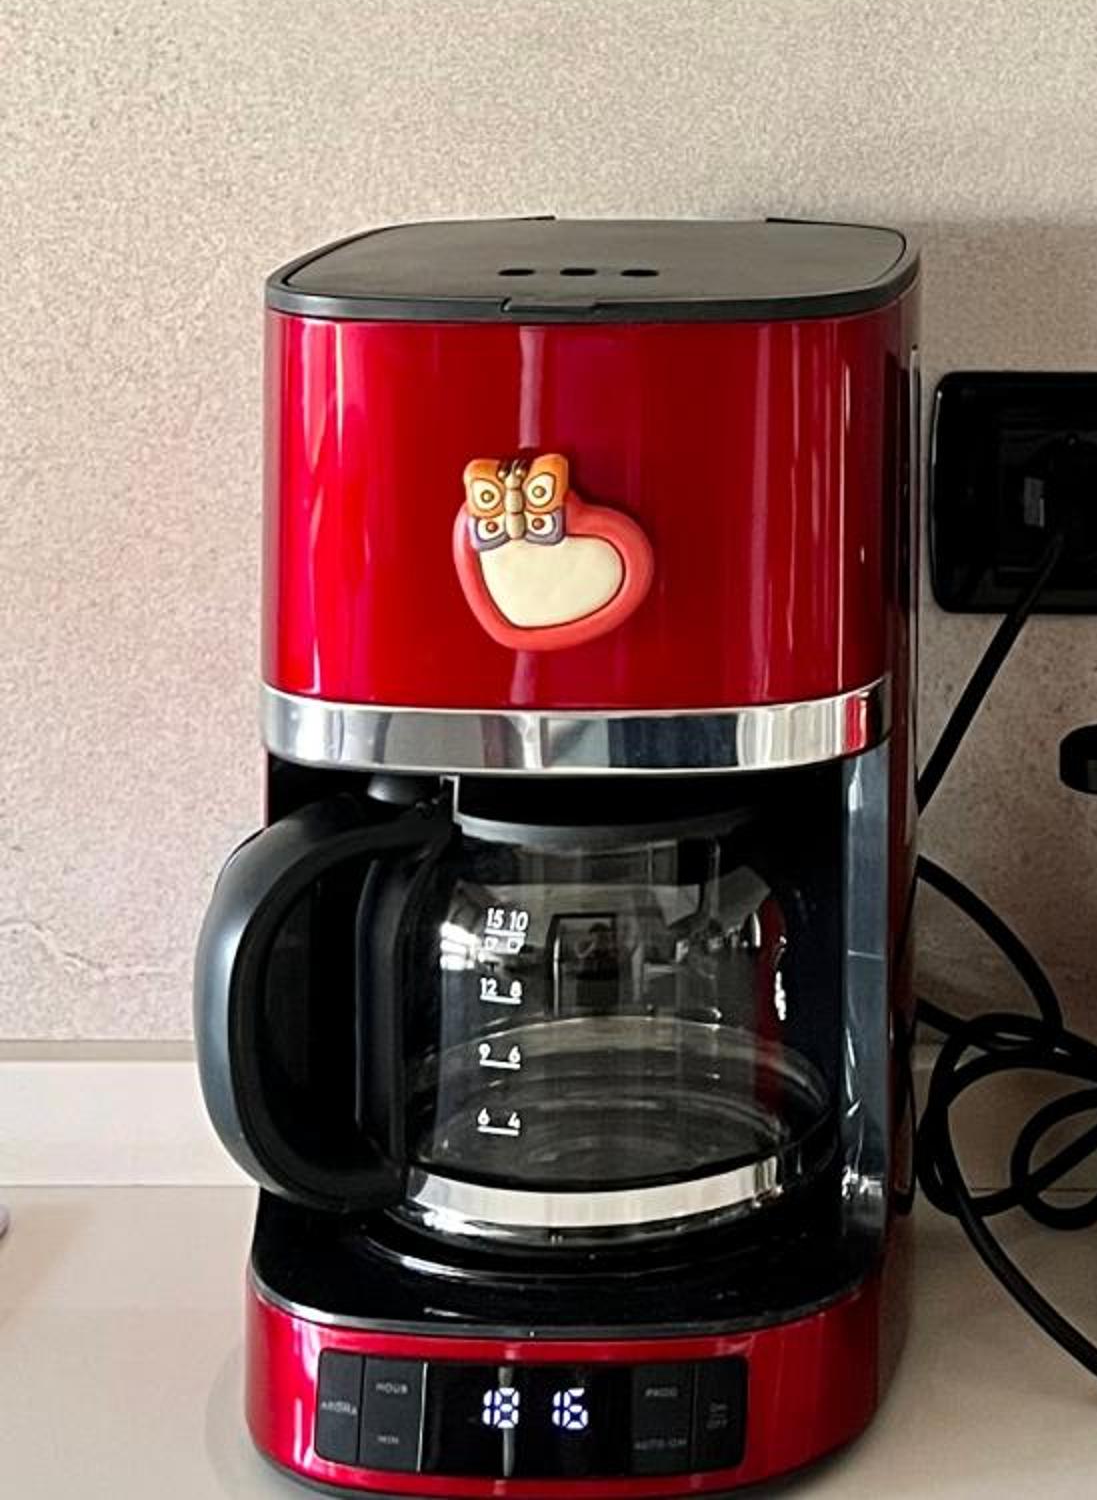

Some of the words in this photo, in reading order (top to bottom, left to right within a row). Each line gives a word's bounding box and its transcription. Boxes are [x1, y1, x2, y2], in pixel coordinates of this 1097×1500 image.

[487, 907, 504, 930] 15
[509, 910, 528, 932] 10
[479, 977, 498, 996] 12
[509, 980, 523, 998] 8
[478, 1043, 491, 1061] 9
[508, 1045, 521, 1063] 6
[477, 1107, 490, 1126] 6
[507, 1111, 521, 1129] 4
